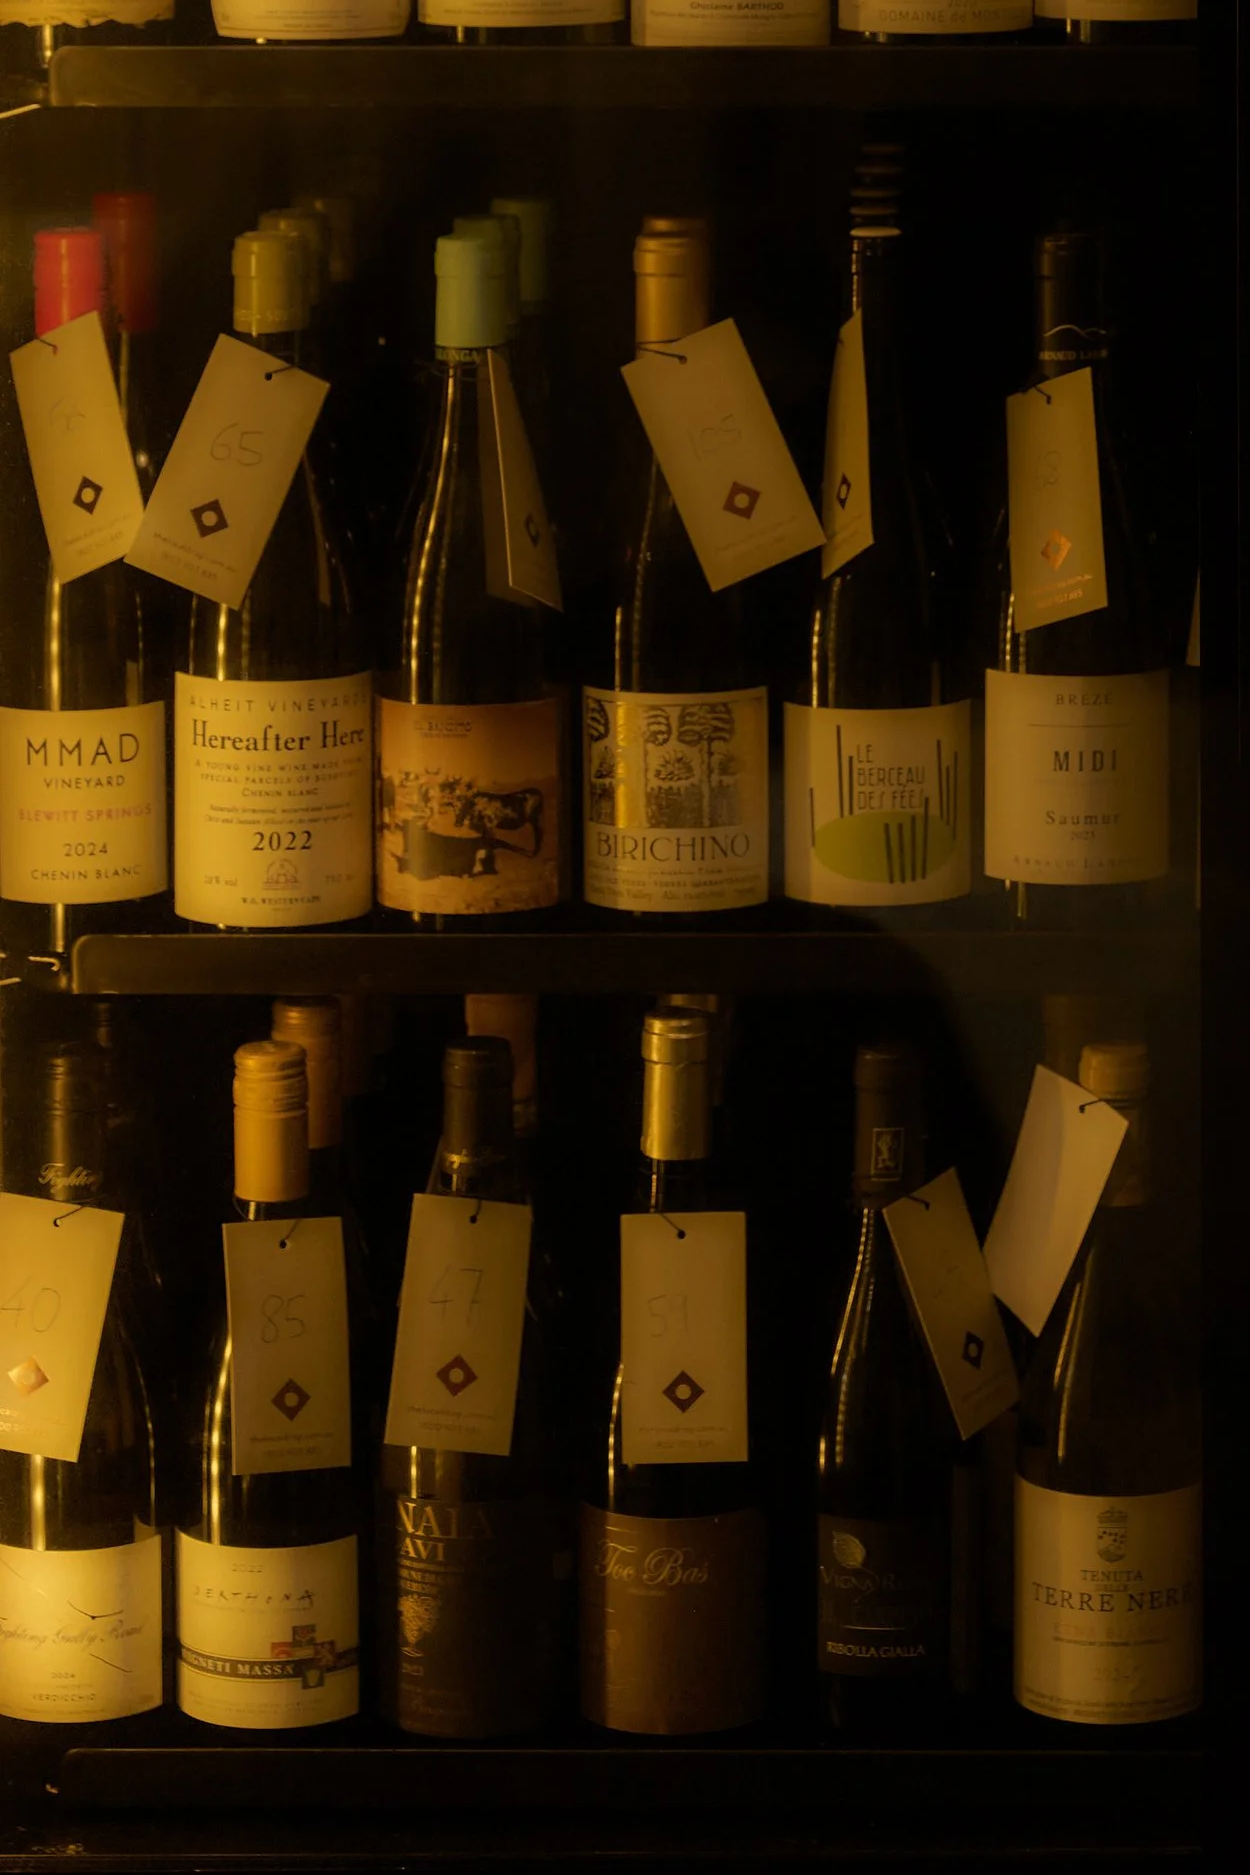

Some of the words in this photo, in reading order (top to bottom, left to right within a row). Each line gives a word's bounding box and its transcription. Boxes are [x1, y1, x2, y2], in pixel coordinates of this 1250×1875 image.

[209, 421, 263, 468] 65
[191, 717, 311, 752] Hereafter
[320, 718, 366, 750] Here
[26, 732, 141, 767] MMAD
[856, 744, 875, 764] LE
[1052, 748, 1119, 774] MIDI
[43, 774, 126, 791] VINEYARD
[857, 766, 926, 787] BERCEAU
[857, 788, 885, 810] DES
[17, 807, 81, 824] BLEWITT
[86, 802, 153, 823] SPRINGS
[1044, 809, 1121, 827] Saumur
[62, 841, 109, 858] 2024
[250, 829, 315, 853] 2022
[595, 832, 751, 863] BIRICHINO
[31, 868, 90, 881] CHENIN
[95, 863, 142, 880] BLANC
[0, 1275, 62, 1334] 40
[428, 1263, 486, 1328] 47
[259, 1292, 307, 1344] 85
[641, 1545, 711, 1587] Bas
[1079, 1568, 1145, 1583] TENUTA
[1031, 1581, 1116, 1613] TERRE
[236, 1661, 295, 1677] MASSA
